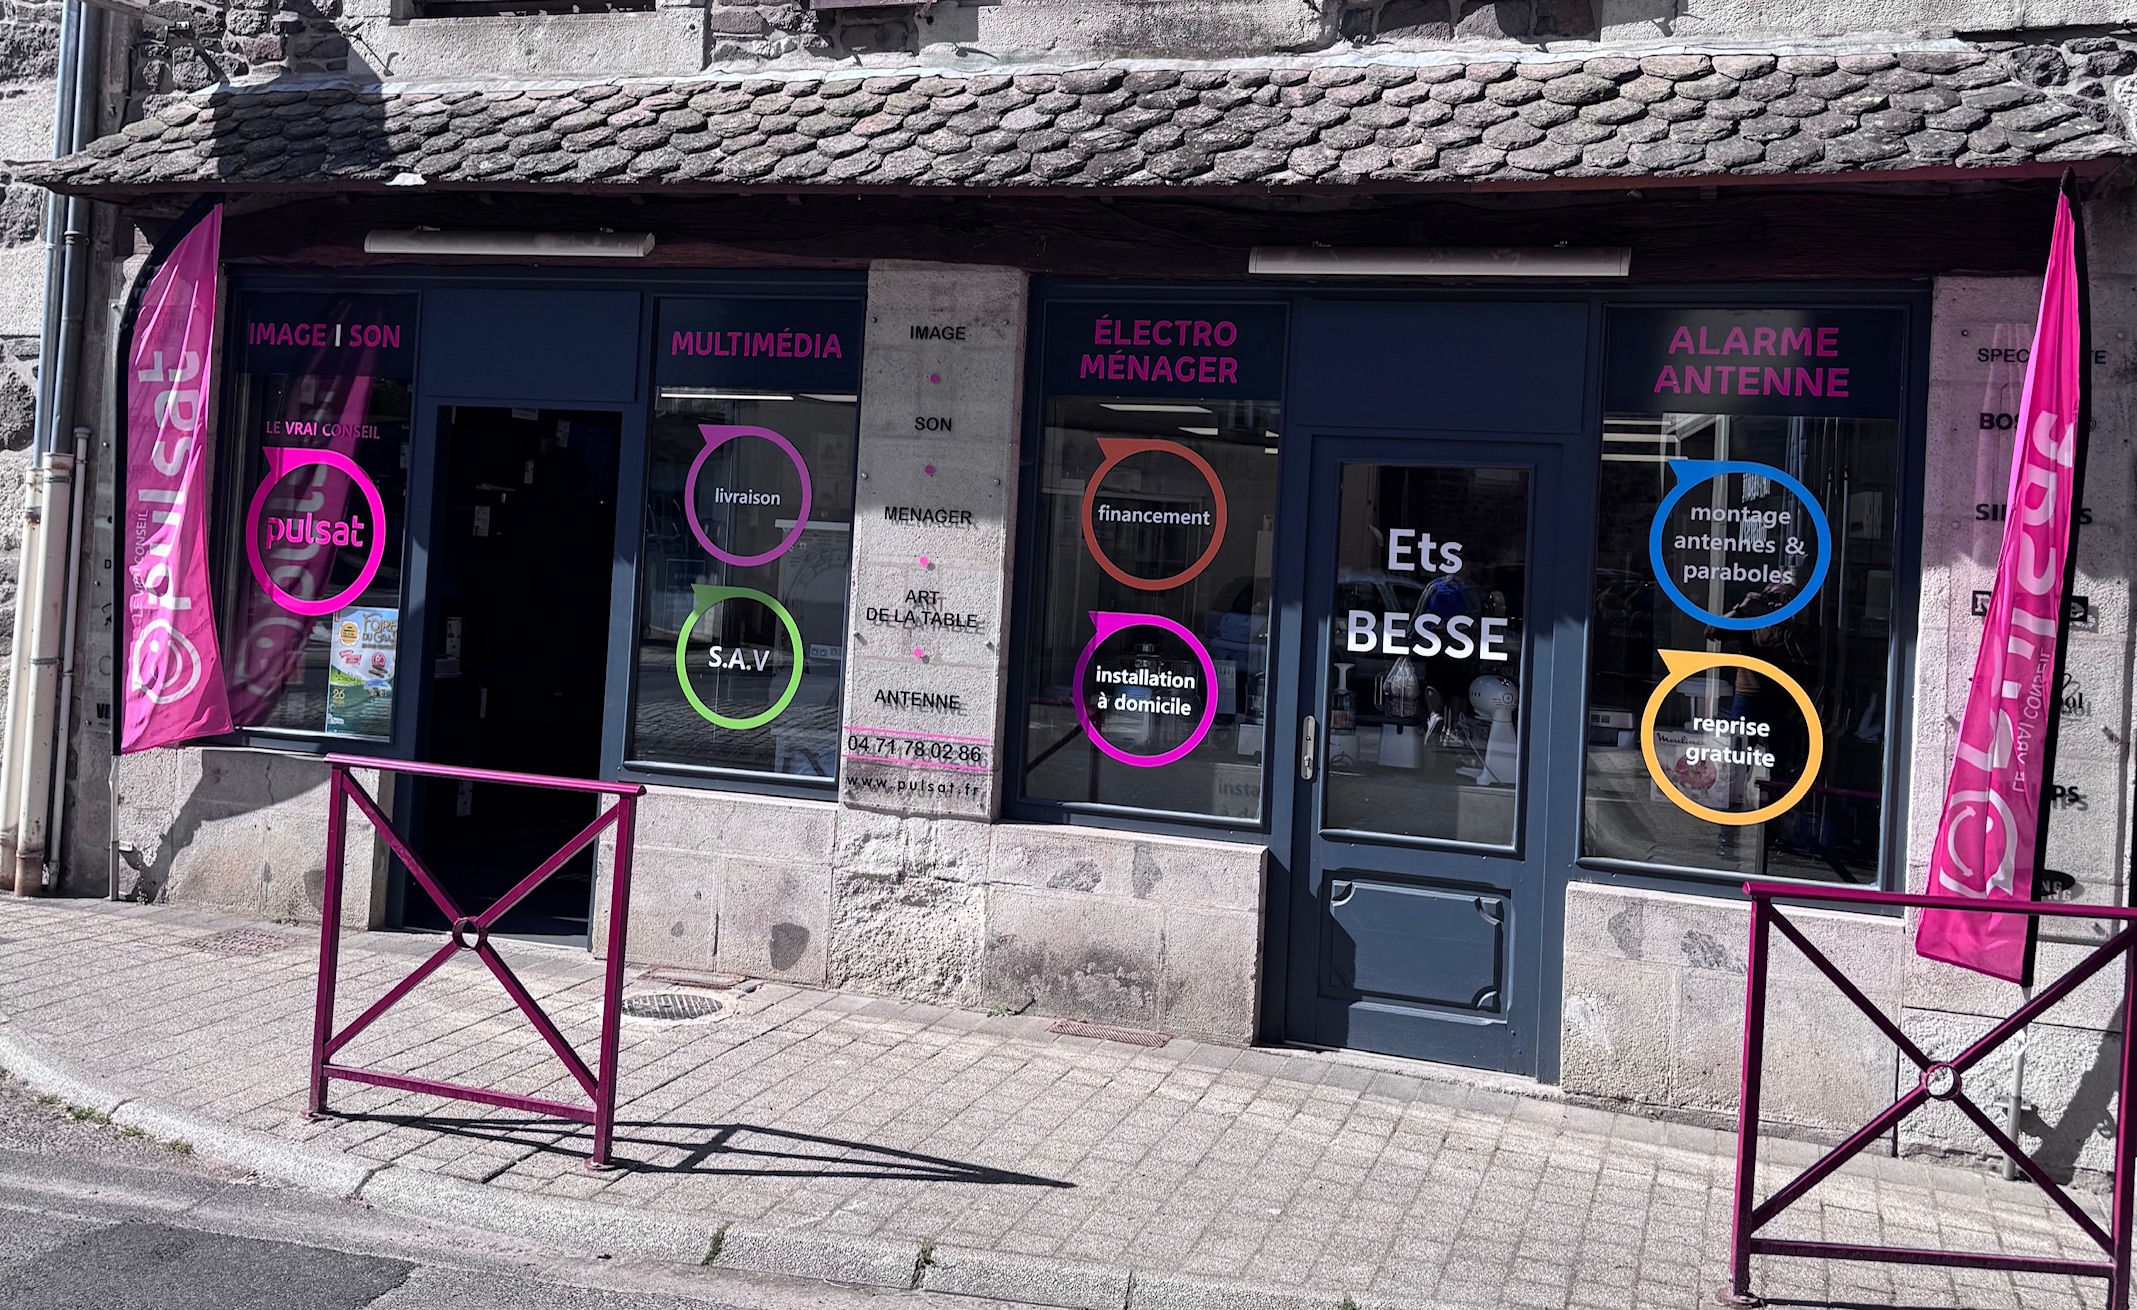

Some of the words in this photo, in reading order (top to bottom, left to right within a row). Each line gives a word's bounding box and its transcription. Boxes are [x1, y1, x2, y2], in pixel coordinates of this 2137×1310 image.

[249, 323, 326, 347] IMAGE
[349, 325, 401, 347] SON
[910, 326, 966, 341] IMAGE
[1094, 314, 1238, 347] ÉLECTRO
[1668, 325, 1839, 357] ALARME
[671, 328, 842, 359] MULTIMÉDIA
[1080, 349, 1238, 384] MÉNAGER
[1653, 365, 1850, 397] ANTENNE
[265, 421, 281, 434] LE
[285, 421, 318, 436] VRAI
[321, 423, 381, 439] CONSEIL
[914, 416, 952, 431] SON
[714, 488, 781, 505] livraison
[884, 506, 972, 524] MENAGER
[1097, 504, 1211, 526] financement
[1690, 505, 1791, 529] montage
[134, 509, 149, 564] CONSEIL
[265, 512, 365, 549] pulsat
[1387, 528, 1464, 574] Ets
[1673, 533, 1776, 553] antennes
[1784, 536, 1806, 556] &
[1683, 562, 1793, 585] paraboles
[905, 589, 940, 605] ART
[866, 607, 889, 621] DE
[894, 608, 916, 624] LA
[921, 611, 978, 628] TABLE
[1346, 610, 1509, 661] BESSE
[708, 645, 770, 671] S.A.V
[1096, 665, 1196, 689] installation
[874, 689, 960, 709] ANTENNE
[1097, 692, 1108, 709] à
[1114, 694, 1192, 715] domicile
[1692, 715, 1771, 738] reprise
[847, 735, 870, 751] 04
[876, 738, 896, 754] 71
[904, 740, 925, 757] 78
[931, 743, 952, 760] 02
[958, 745, 982, 762] 86
[1685, 745, 1776, 768] gratuite
